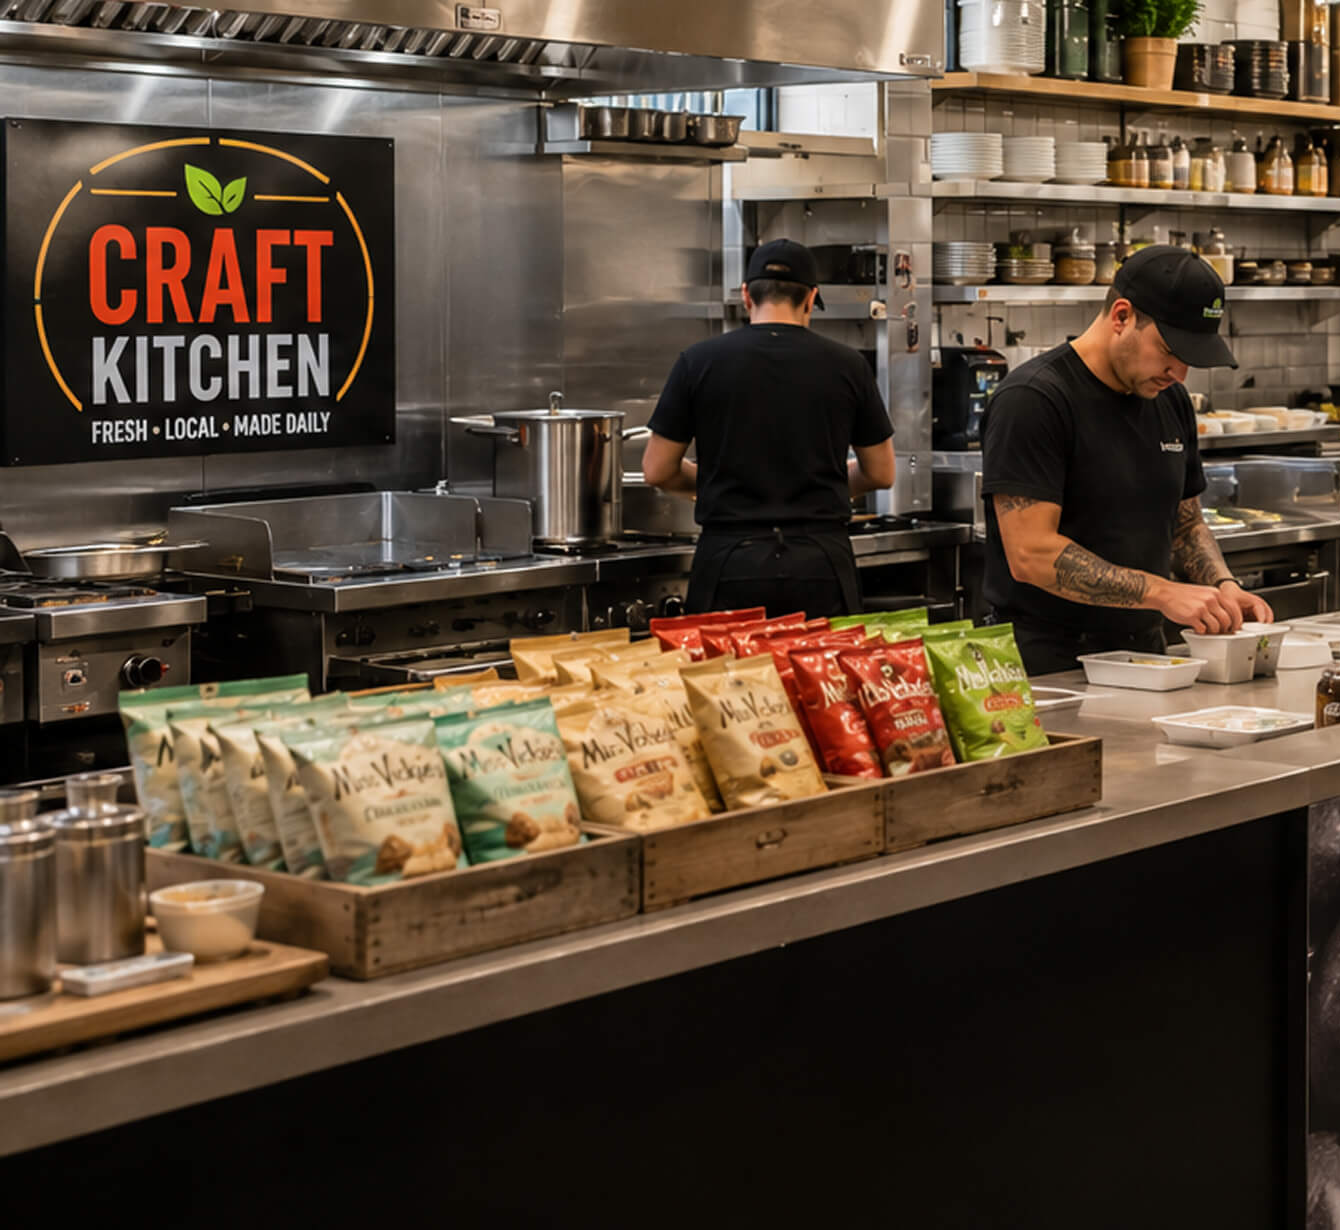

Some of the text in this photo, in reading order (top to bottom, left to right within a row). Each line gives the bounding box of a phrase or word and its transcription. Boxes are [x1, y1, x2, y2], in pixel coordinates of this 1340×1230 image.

[89, 224, 334, 325] CRAFT
[92, 333, 330, 405] KITCHEN
[91, 411, 331, 444] FRESH LOCAL MADE DAILY
